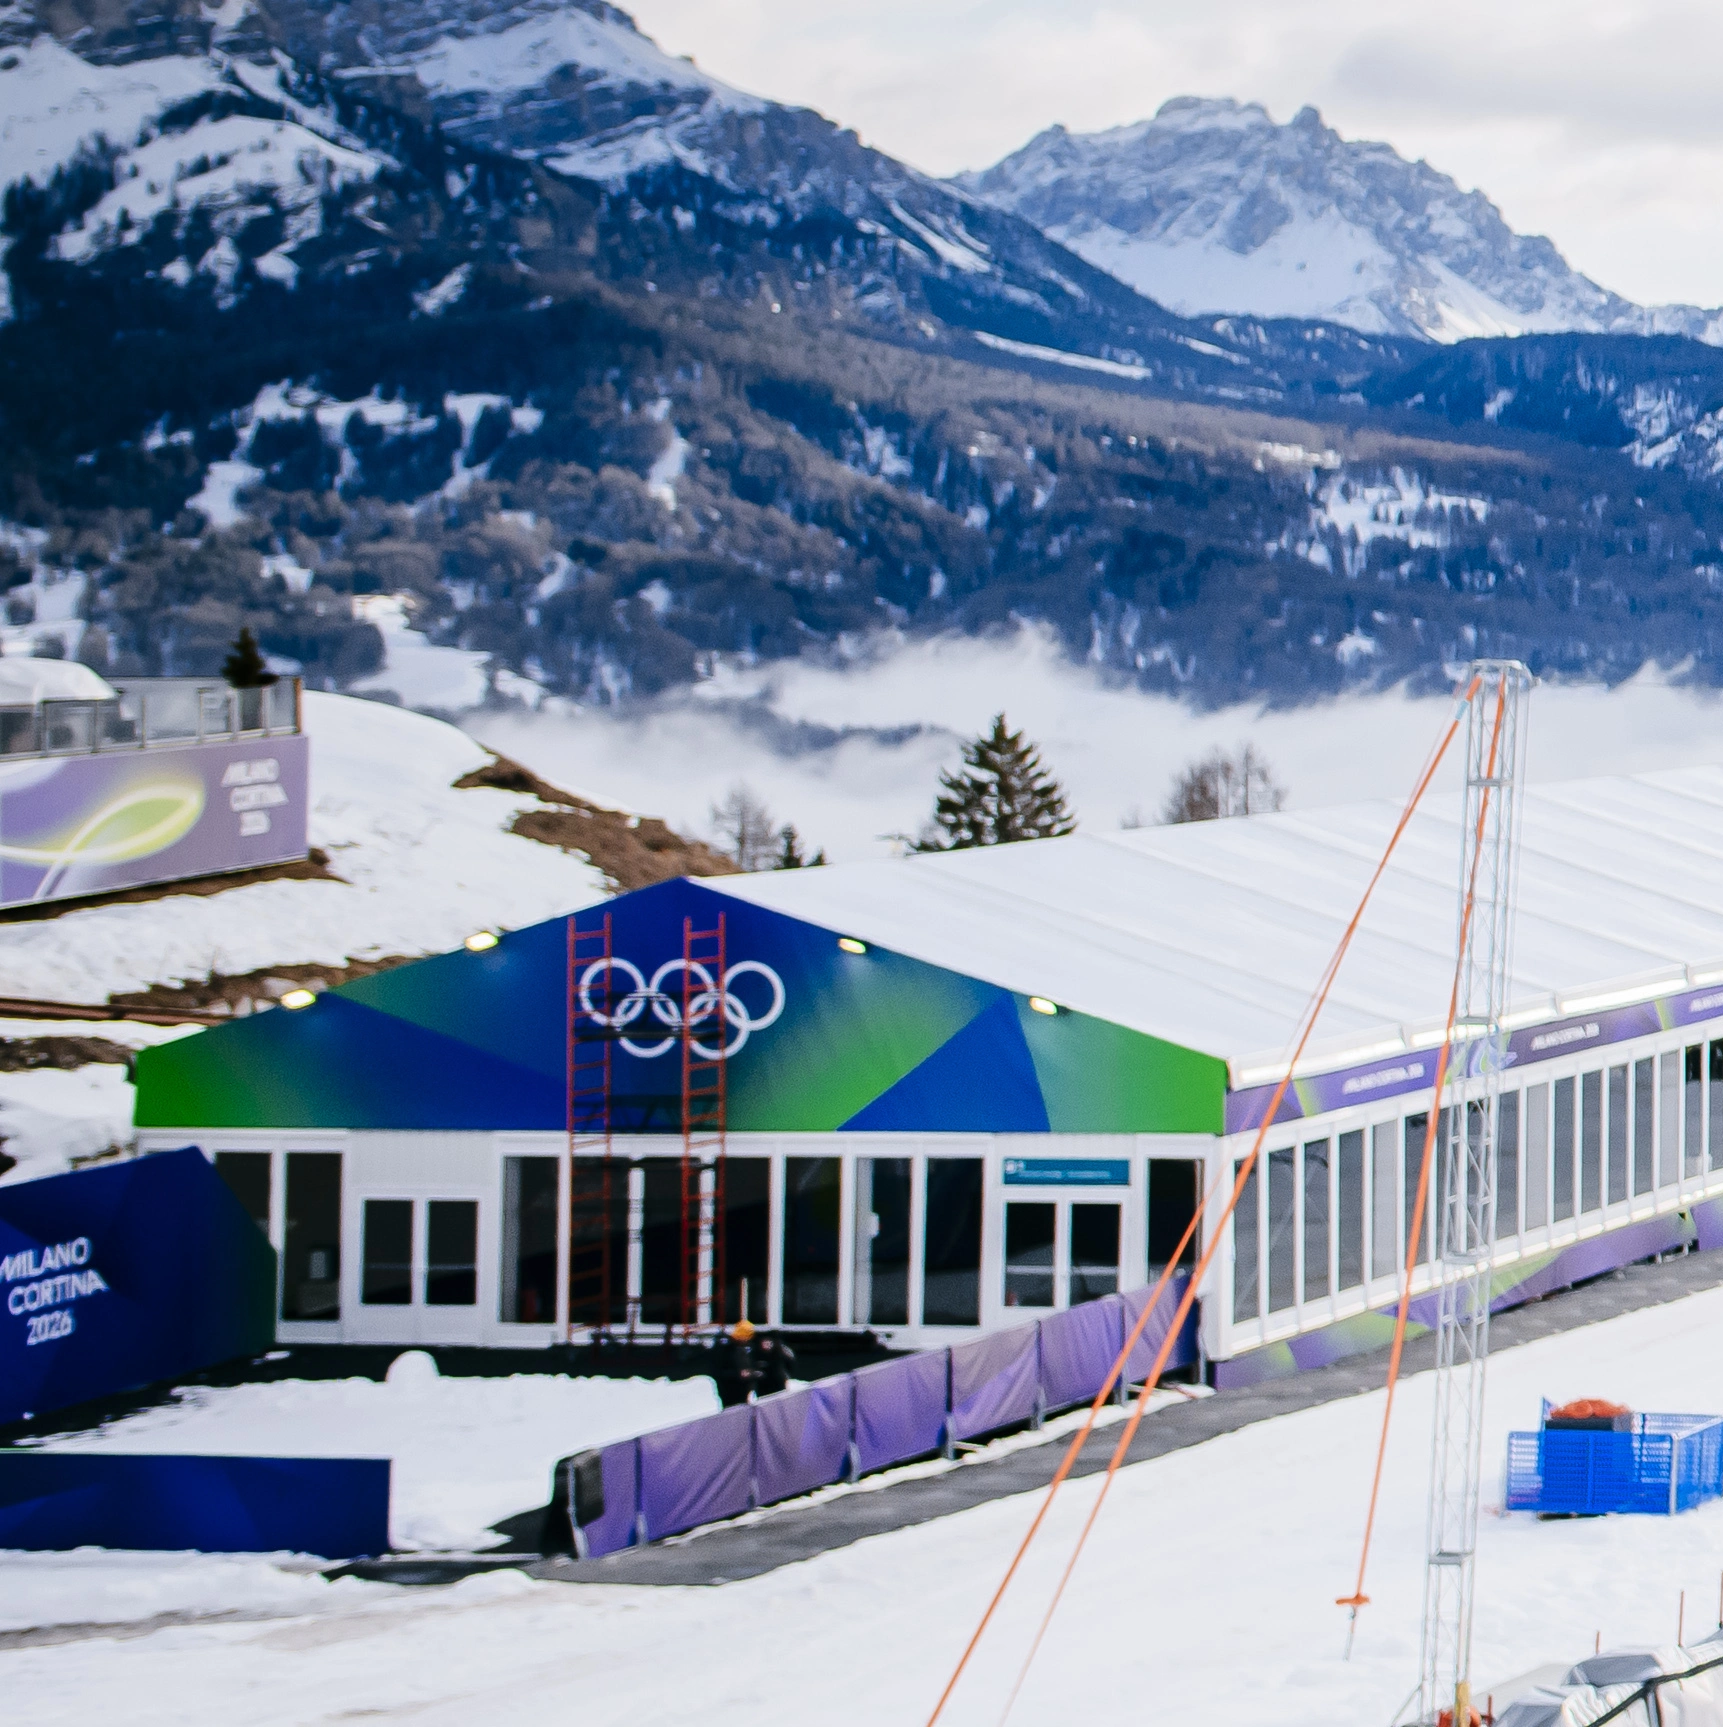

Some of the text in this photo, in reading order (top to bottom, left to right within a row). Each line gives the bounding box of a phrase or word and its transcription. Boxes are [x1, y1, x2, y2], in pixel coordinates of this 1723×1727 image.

[0, 1236, 91, 1282] MILANO
[8, 1269, 109, 1315] CORTINA
[26, 1308, 76, 1346] 2026
